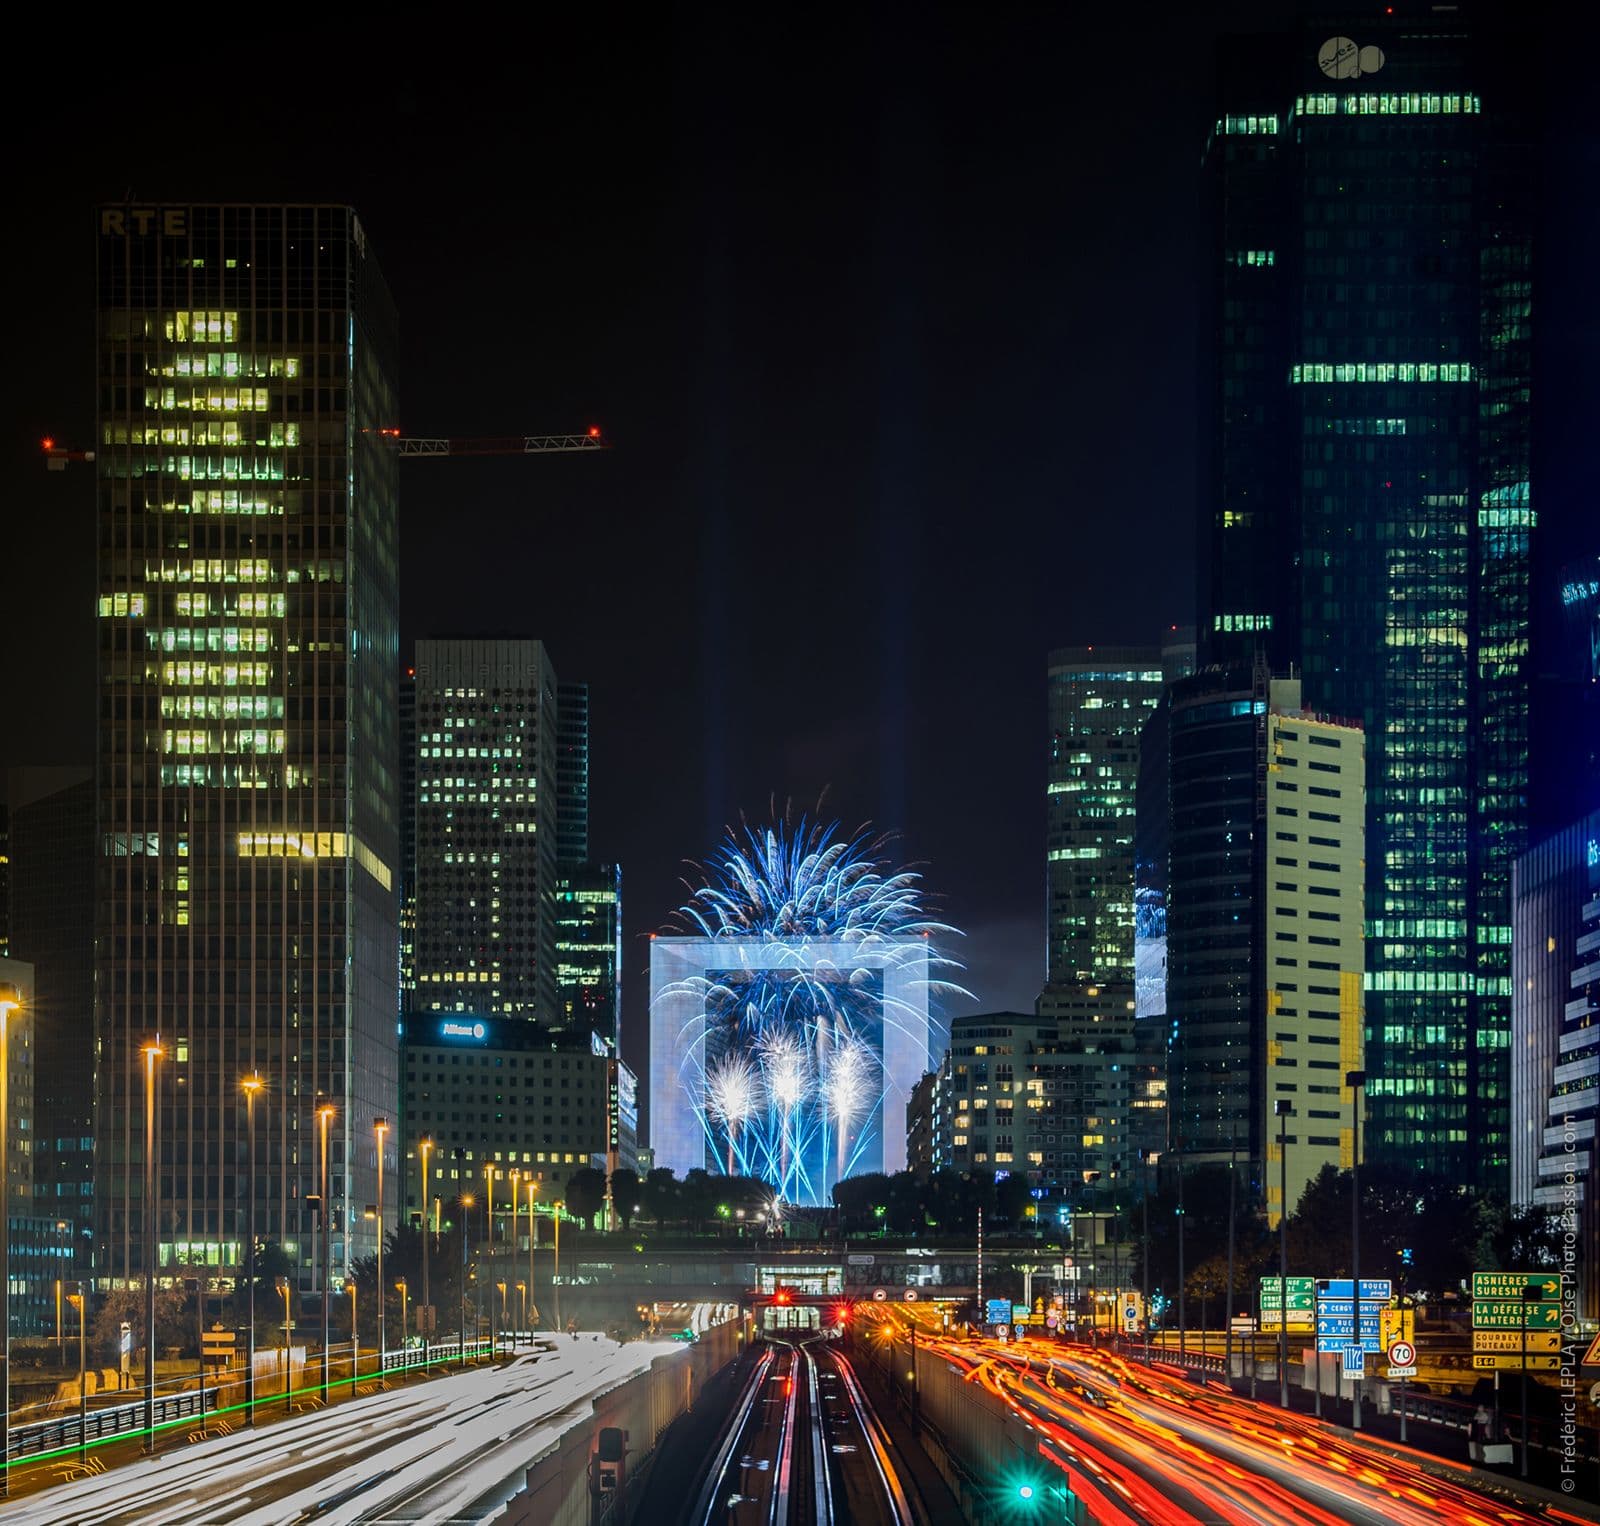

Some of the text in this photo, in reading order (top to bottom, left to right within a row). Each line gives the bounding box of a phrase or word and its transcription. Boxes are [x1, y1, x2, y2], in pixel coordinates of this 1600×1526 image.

[1321, 43, 1355, 68] suez
[102, 209, 185, 235] RTE
[418, 664, 537, 675] arane
[1477, 1274, 1528, 1286] ASNIÈRES
[1477, 1287, 1525, 1296] SURESNE
[1476, 1305, 1488, 1314] LA
[1128, 1321, 1134, 1330] E
[1476, 1316, 1529, 1325] NANTERRE
[1476, 1334, 1535, 1342] COURBEVIE
[1395, 1348, 1410, 1360] 70
